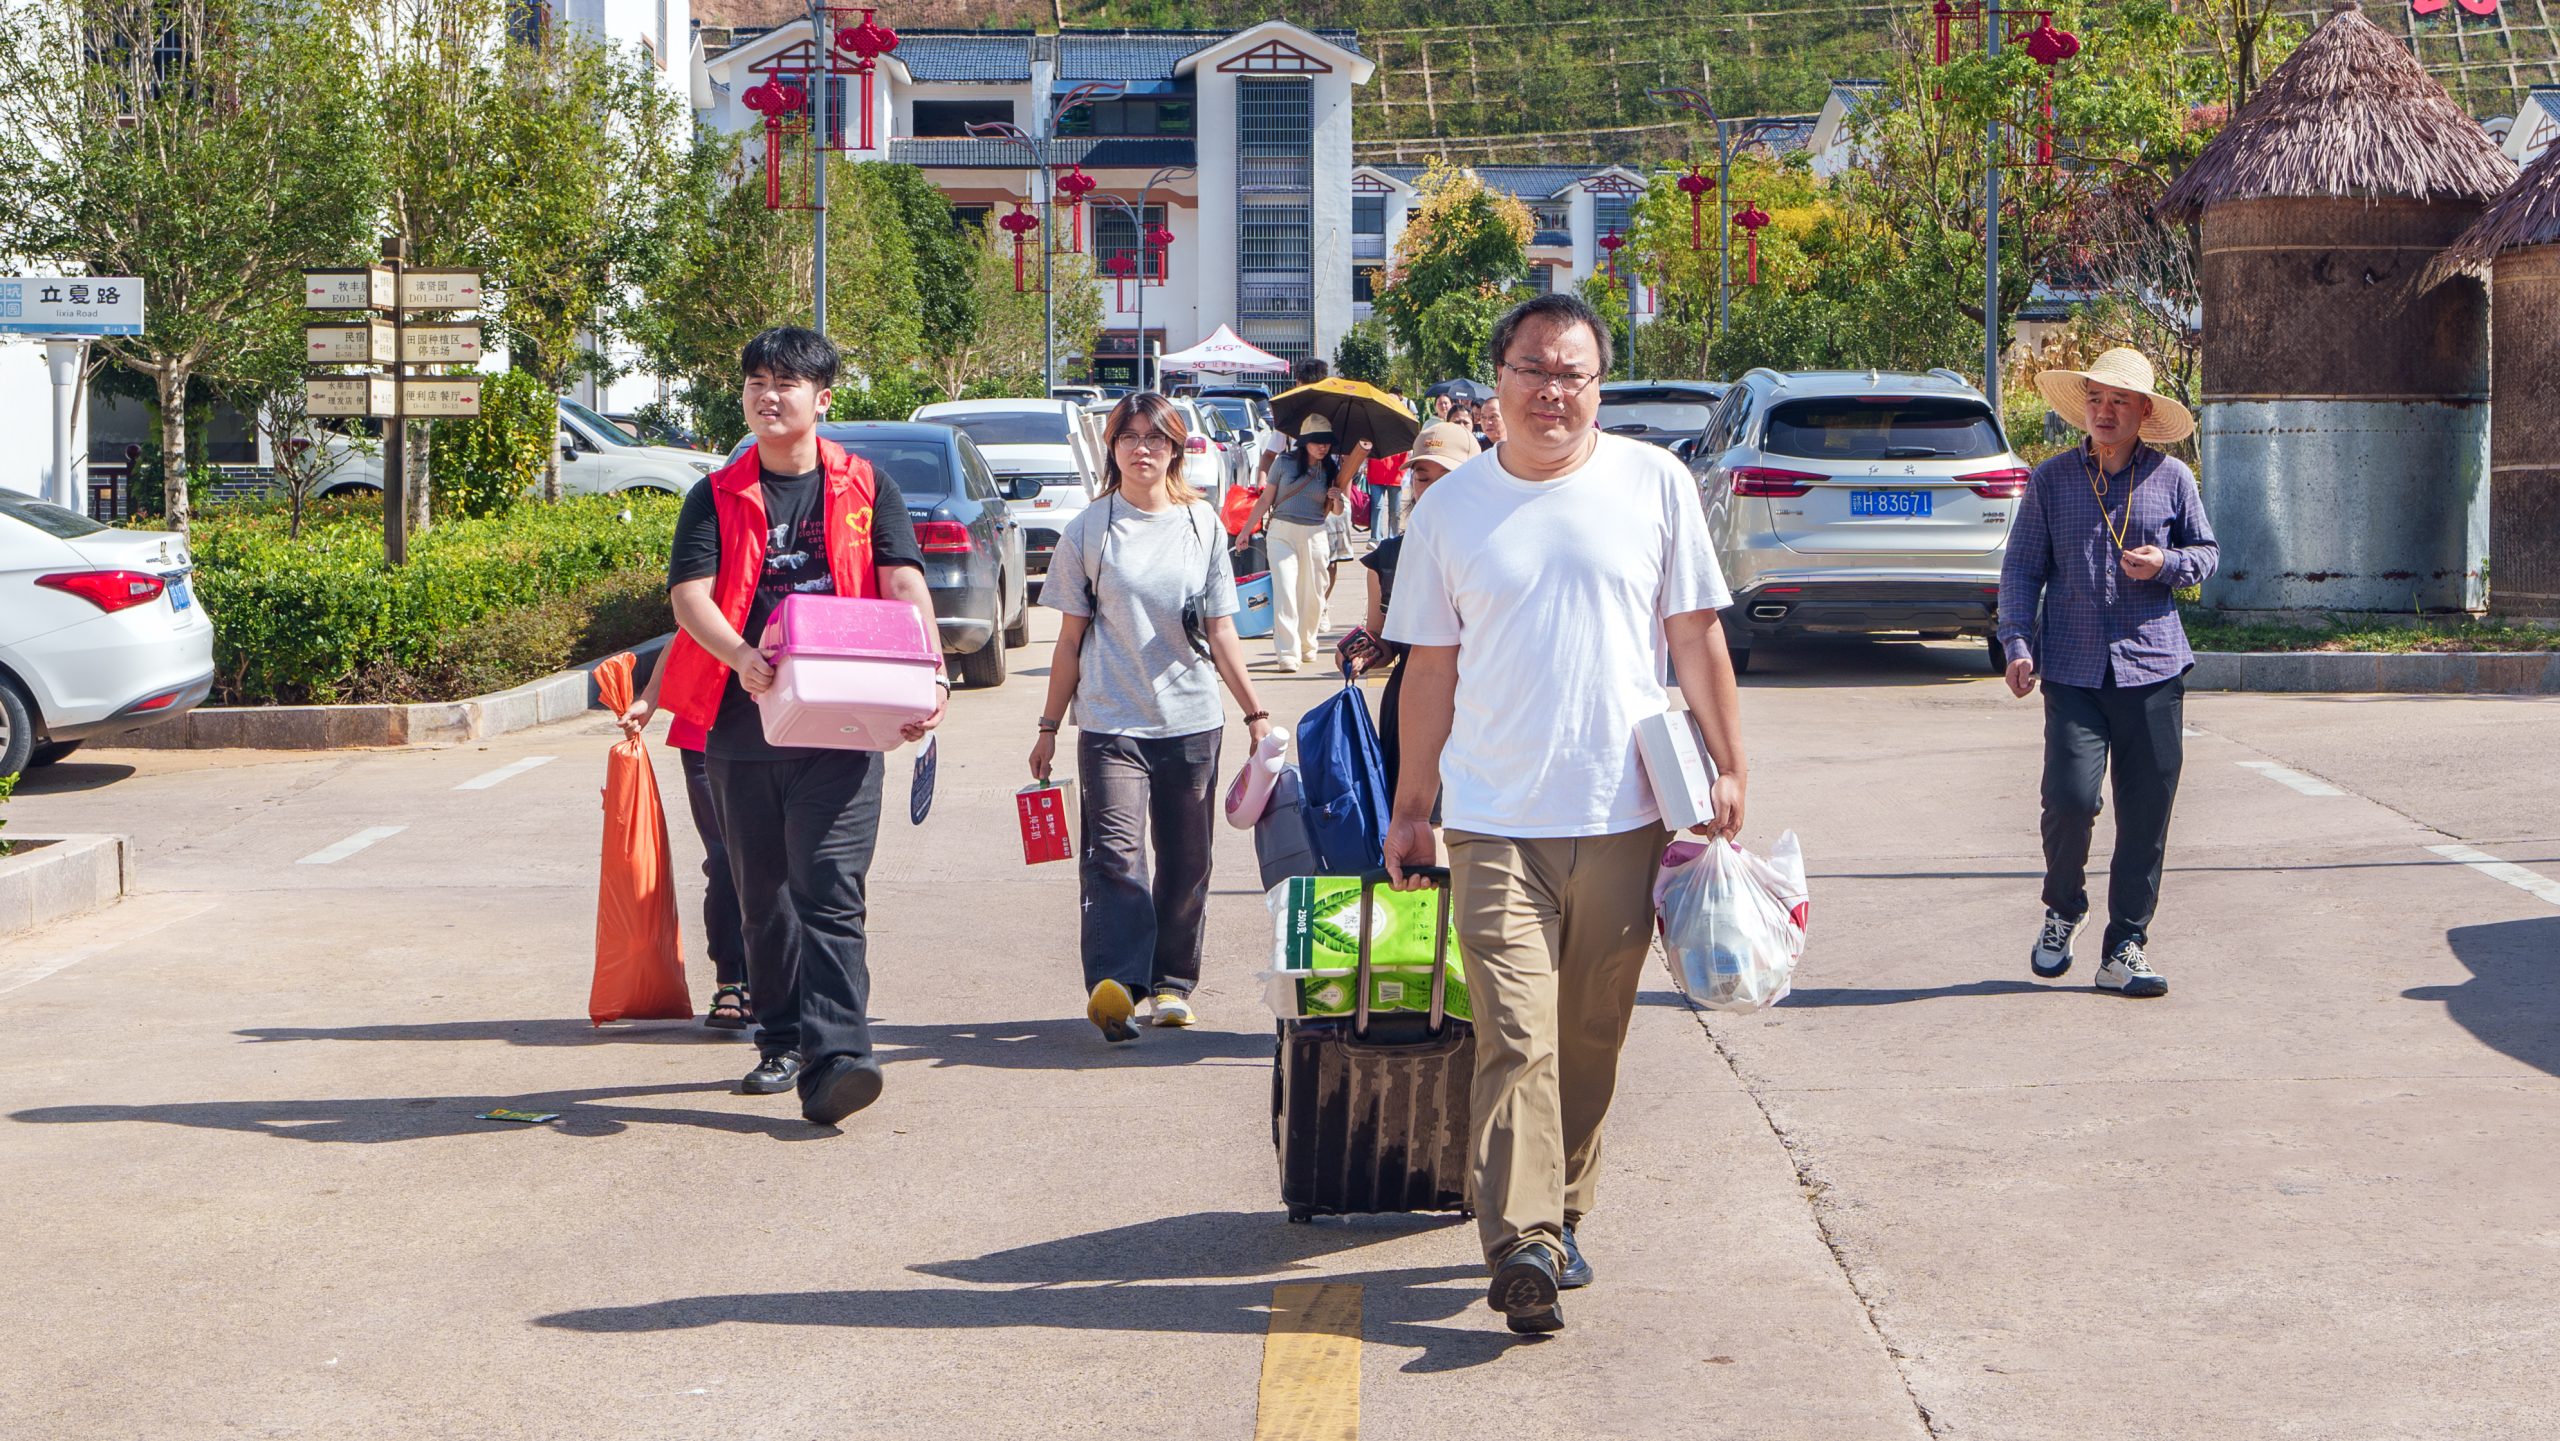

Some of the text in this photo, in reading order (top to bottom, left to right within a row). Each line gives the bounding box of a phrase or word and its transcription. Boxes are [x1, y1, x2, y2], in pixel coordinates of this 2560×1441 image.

[416, 281, 448, 292] 读贤园
[40, 284, 121, 305] 立夏路
[332, 294, 366, 304] E01-E
[409, 294, 455, 303] D01-D47
[76, 309, 98, 318] Road
[345, 332, 366, 343] 民宿
[407, 334, 461, 346] 田园种植区
[418, 345, 450, 357] 停车场
[406, 390, 437, 402] 便利店
[440, 390, 461, 402] 餐厅
[1296, 909, 1308, 935] 2500克
